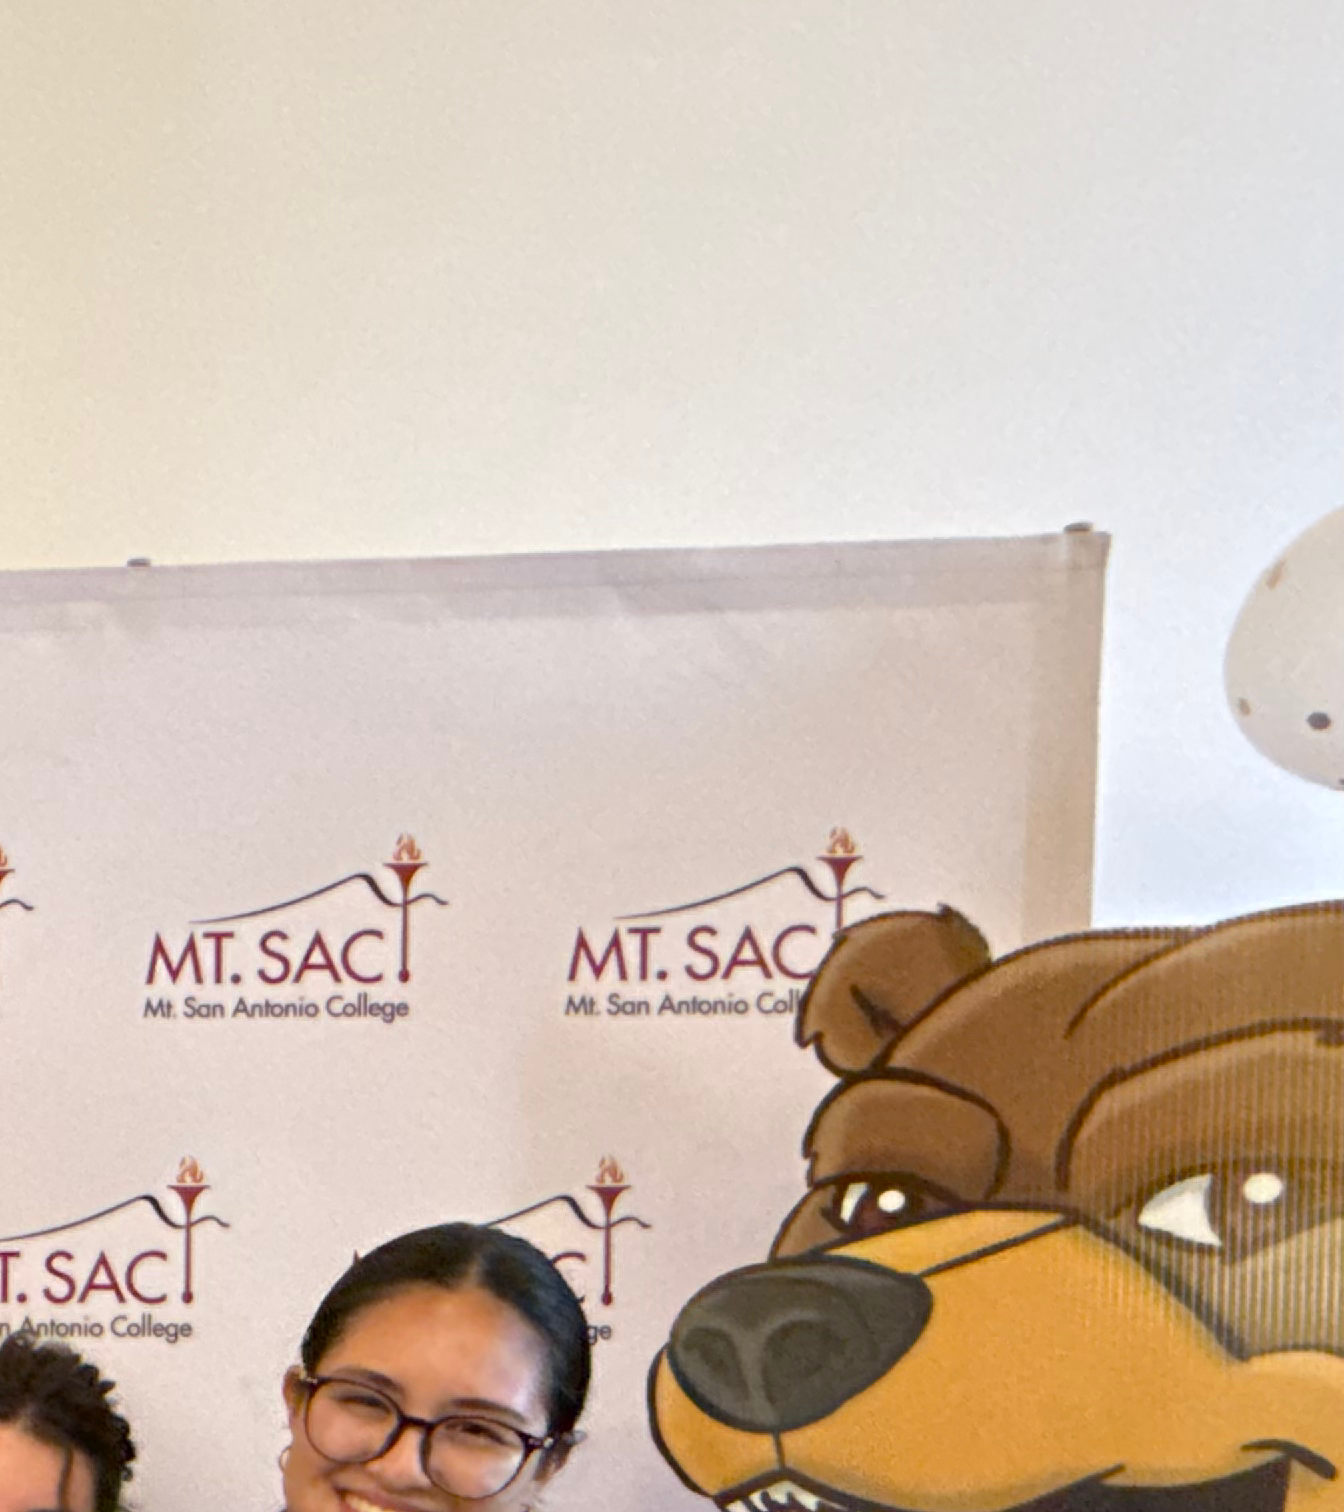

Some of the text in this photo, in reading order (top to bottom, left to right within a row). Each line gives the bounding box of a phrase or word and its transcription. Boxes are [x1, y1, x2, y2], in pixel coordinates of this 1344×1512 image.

[146, 928, 384, 985] MT. SAC
[568, 925, 817, 981] MT. SAC
[143, 991, 410, 1023] Mt. San Antonio College
[565, 988, 801, 1016] Mt. San Antonio Coll
[43, 1249, 168, 1304] SAC
[19, 1316, 103, 1337] Antonio
[111, 1312, 193, 1343] College
